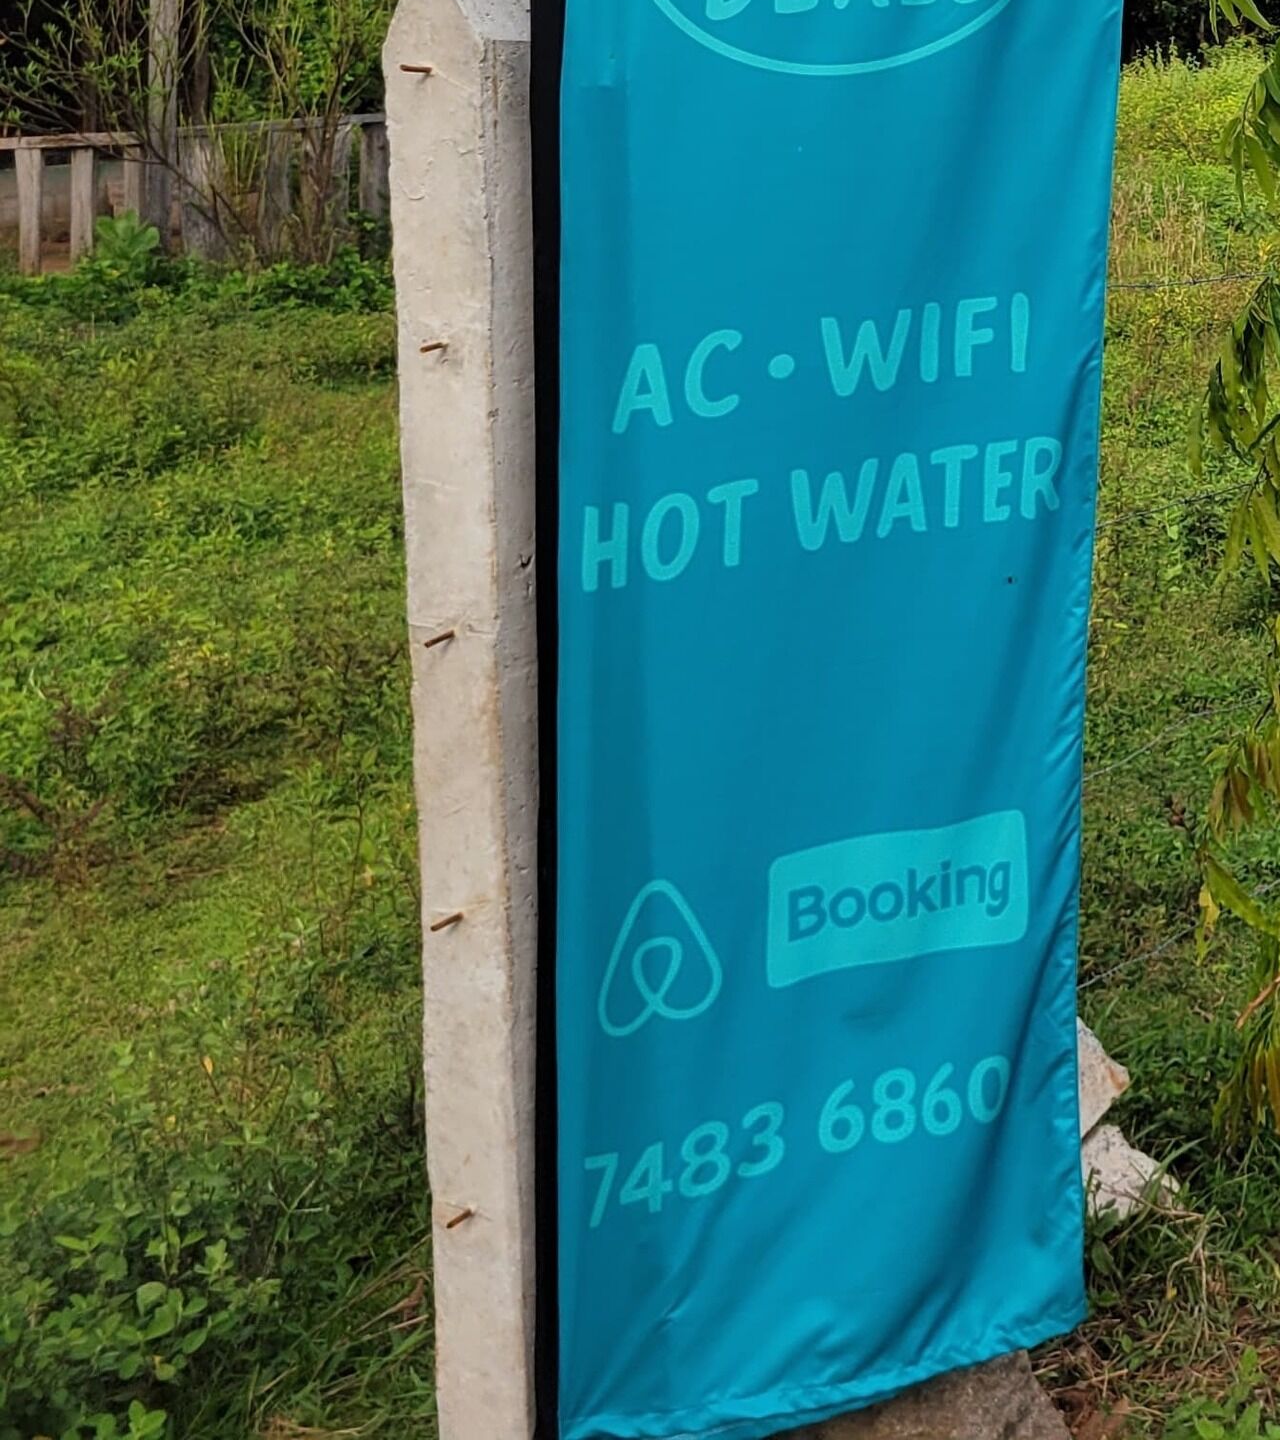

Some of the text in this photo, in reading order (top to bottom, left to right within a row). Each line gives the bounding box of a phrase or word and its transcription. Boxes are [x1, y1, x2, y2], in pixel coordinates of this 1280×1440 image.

[611, 292, 1029, 434] AC WIFI
[580, 436, 1062, 592] HOT WATER
[787, 858, 1012, 943] Booking
[584, 1054, 1012, 1229] 7483 6860
